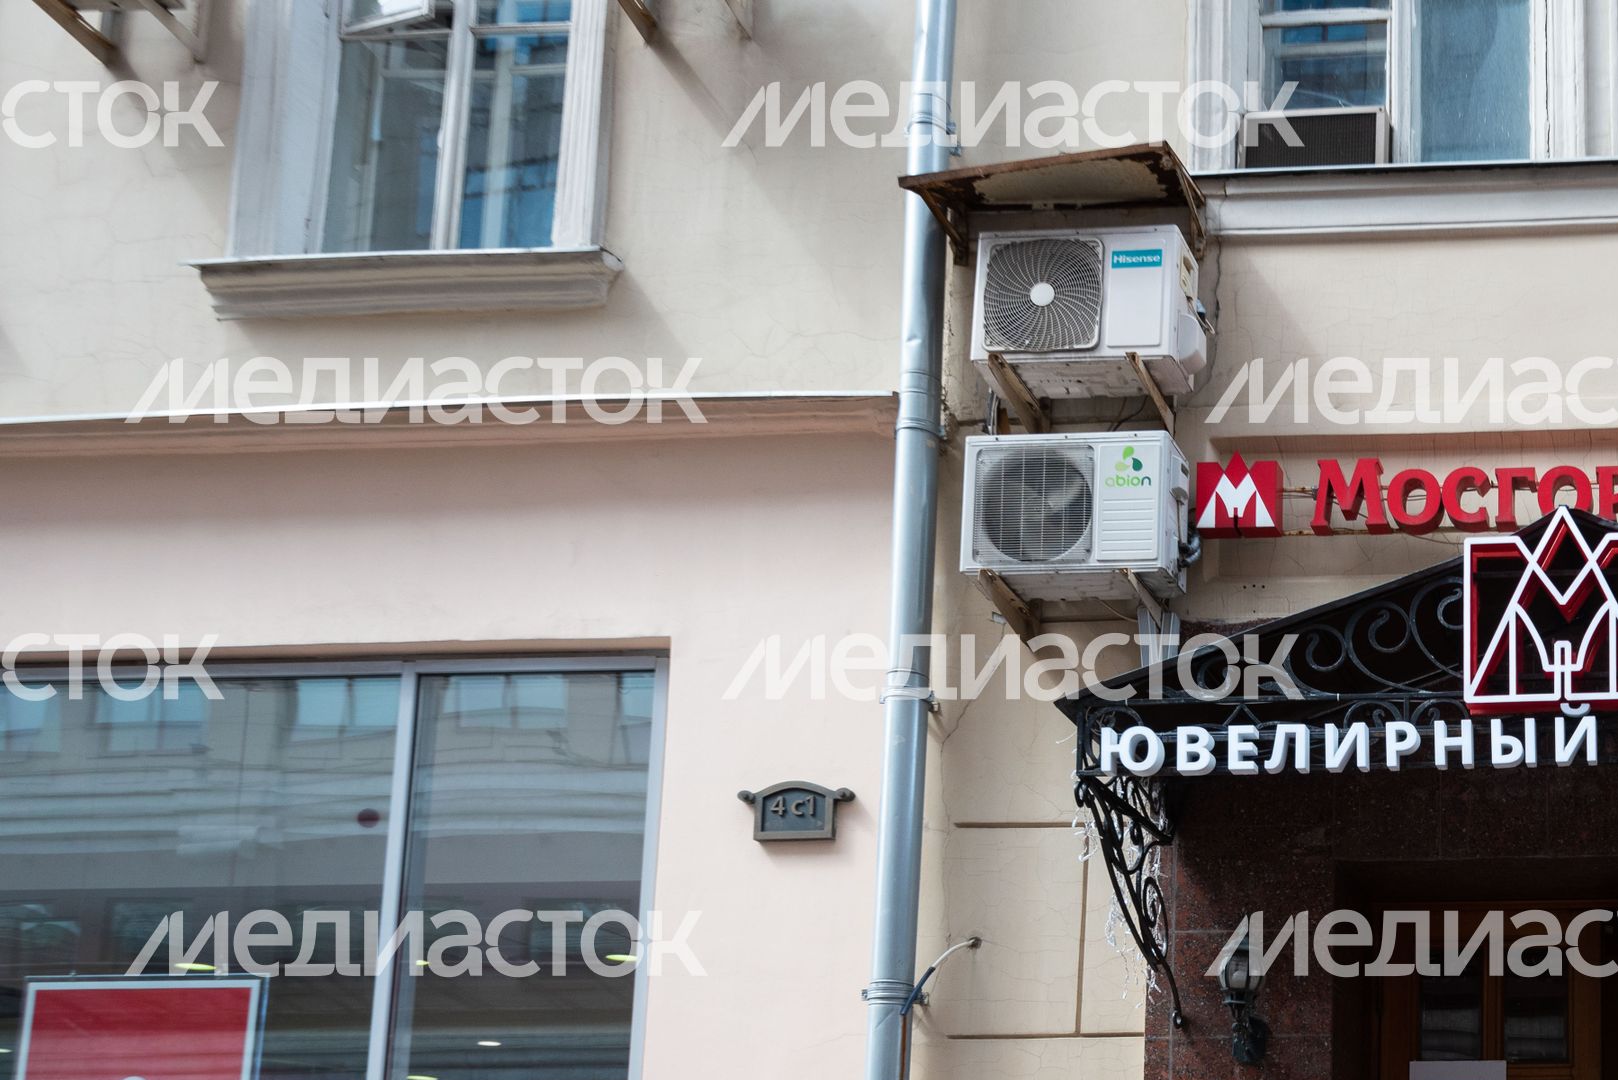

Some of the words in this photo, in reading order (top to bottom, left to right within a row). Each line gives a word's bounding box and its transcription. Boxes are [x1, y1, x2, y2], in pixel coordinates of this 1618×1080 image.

[1113, 254, 1161, 264] Hisense
[1104, 474, 1152, 487] abion
[1100, 701, 1598, 777] ЮВЕЛИРНЫЙ
[770, 795, 787, 816] 4
